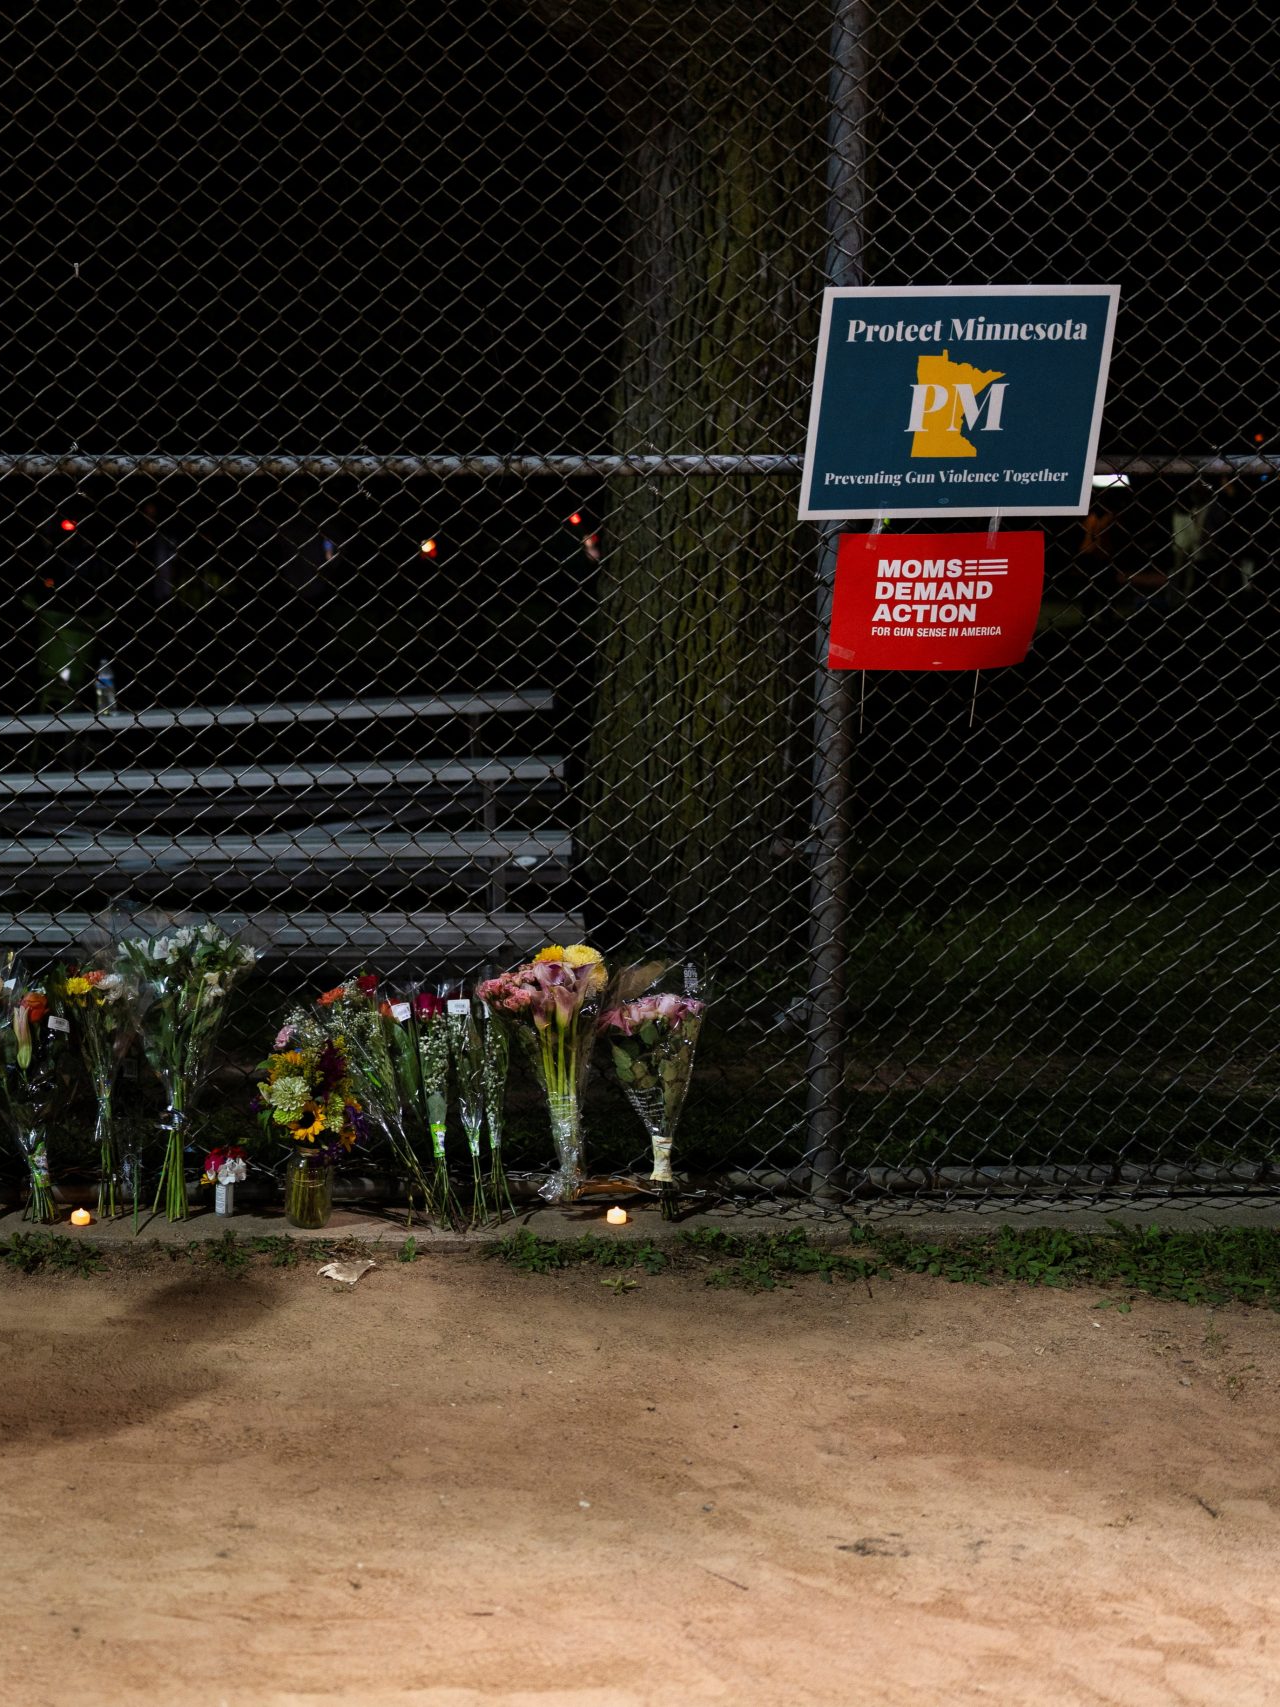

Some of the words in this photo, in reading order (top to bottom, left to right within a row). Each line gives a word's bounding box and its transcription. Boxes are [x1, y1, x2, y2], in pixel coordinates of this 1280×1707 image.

[846, 319, 943, 343] Protect
[948, 316, 1088, 341] Minnesota
[903, 383, 1010, 432] PM
[824, 470, 903, 487] Preventing
[905, 471, 935, 484] Gun
[939, 469, 1000, 483] Violence
[1002, 468, 1069, 485] Together
[876, 558, 963, 579] MOMS
[874, 580, 994, 601] DEMAND
[871, 603, 977, 623] ACTION
[871, 626, 891, 637] FOR
[893, 626, 915, 637] GUN
[915, 627, 948, 638] SENSE
[948, 627, 959, 637] IN
[960, 625, 1002, 637] AMERICA
